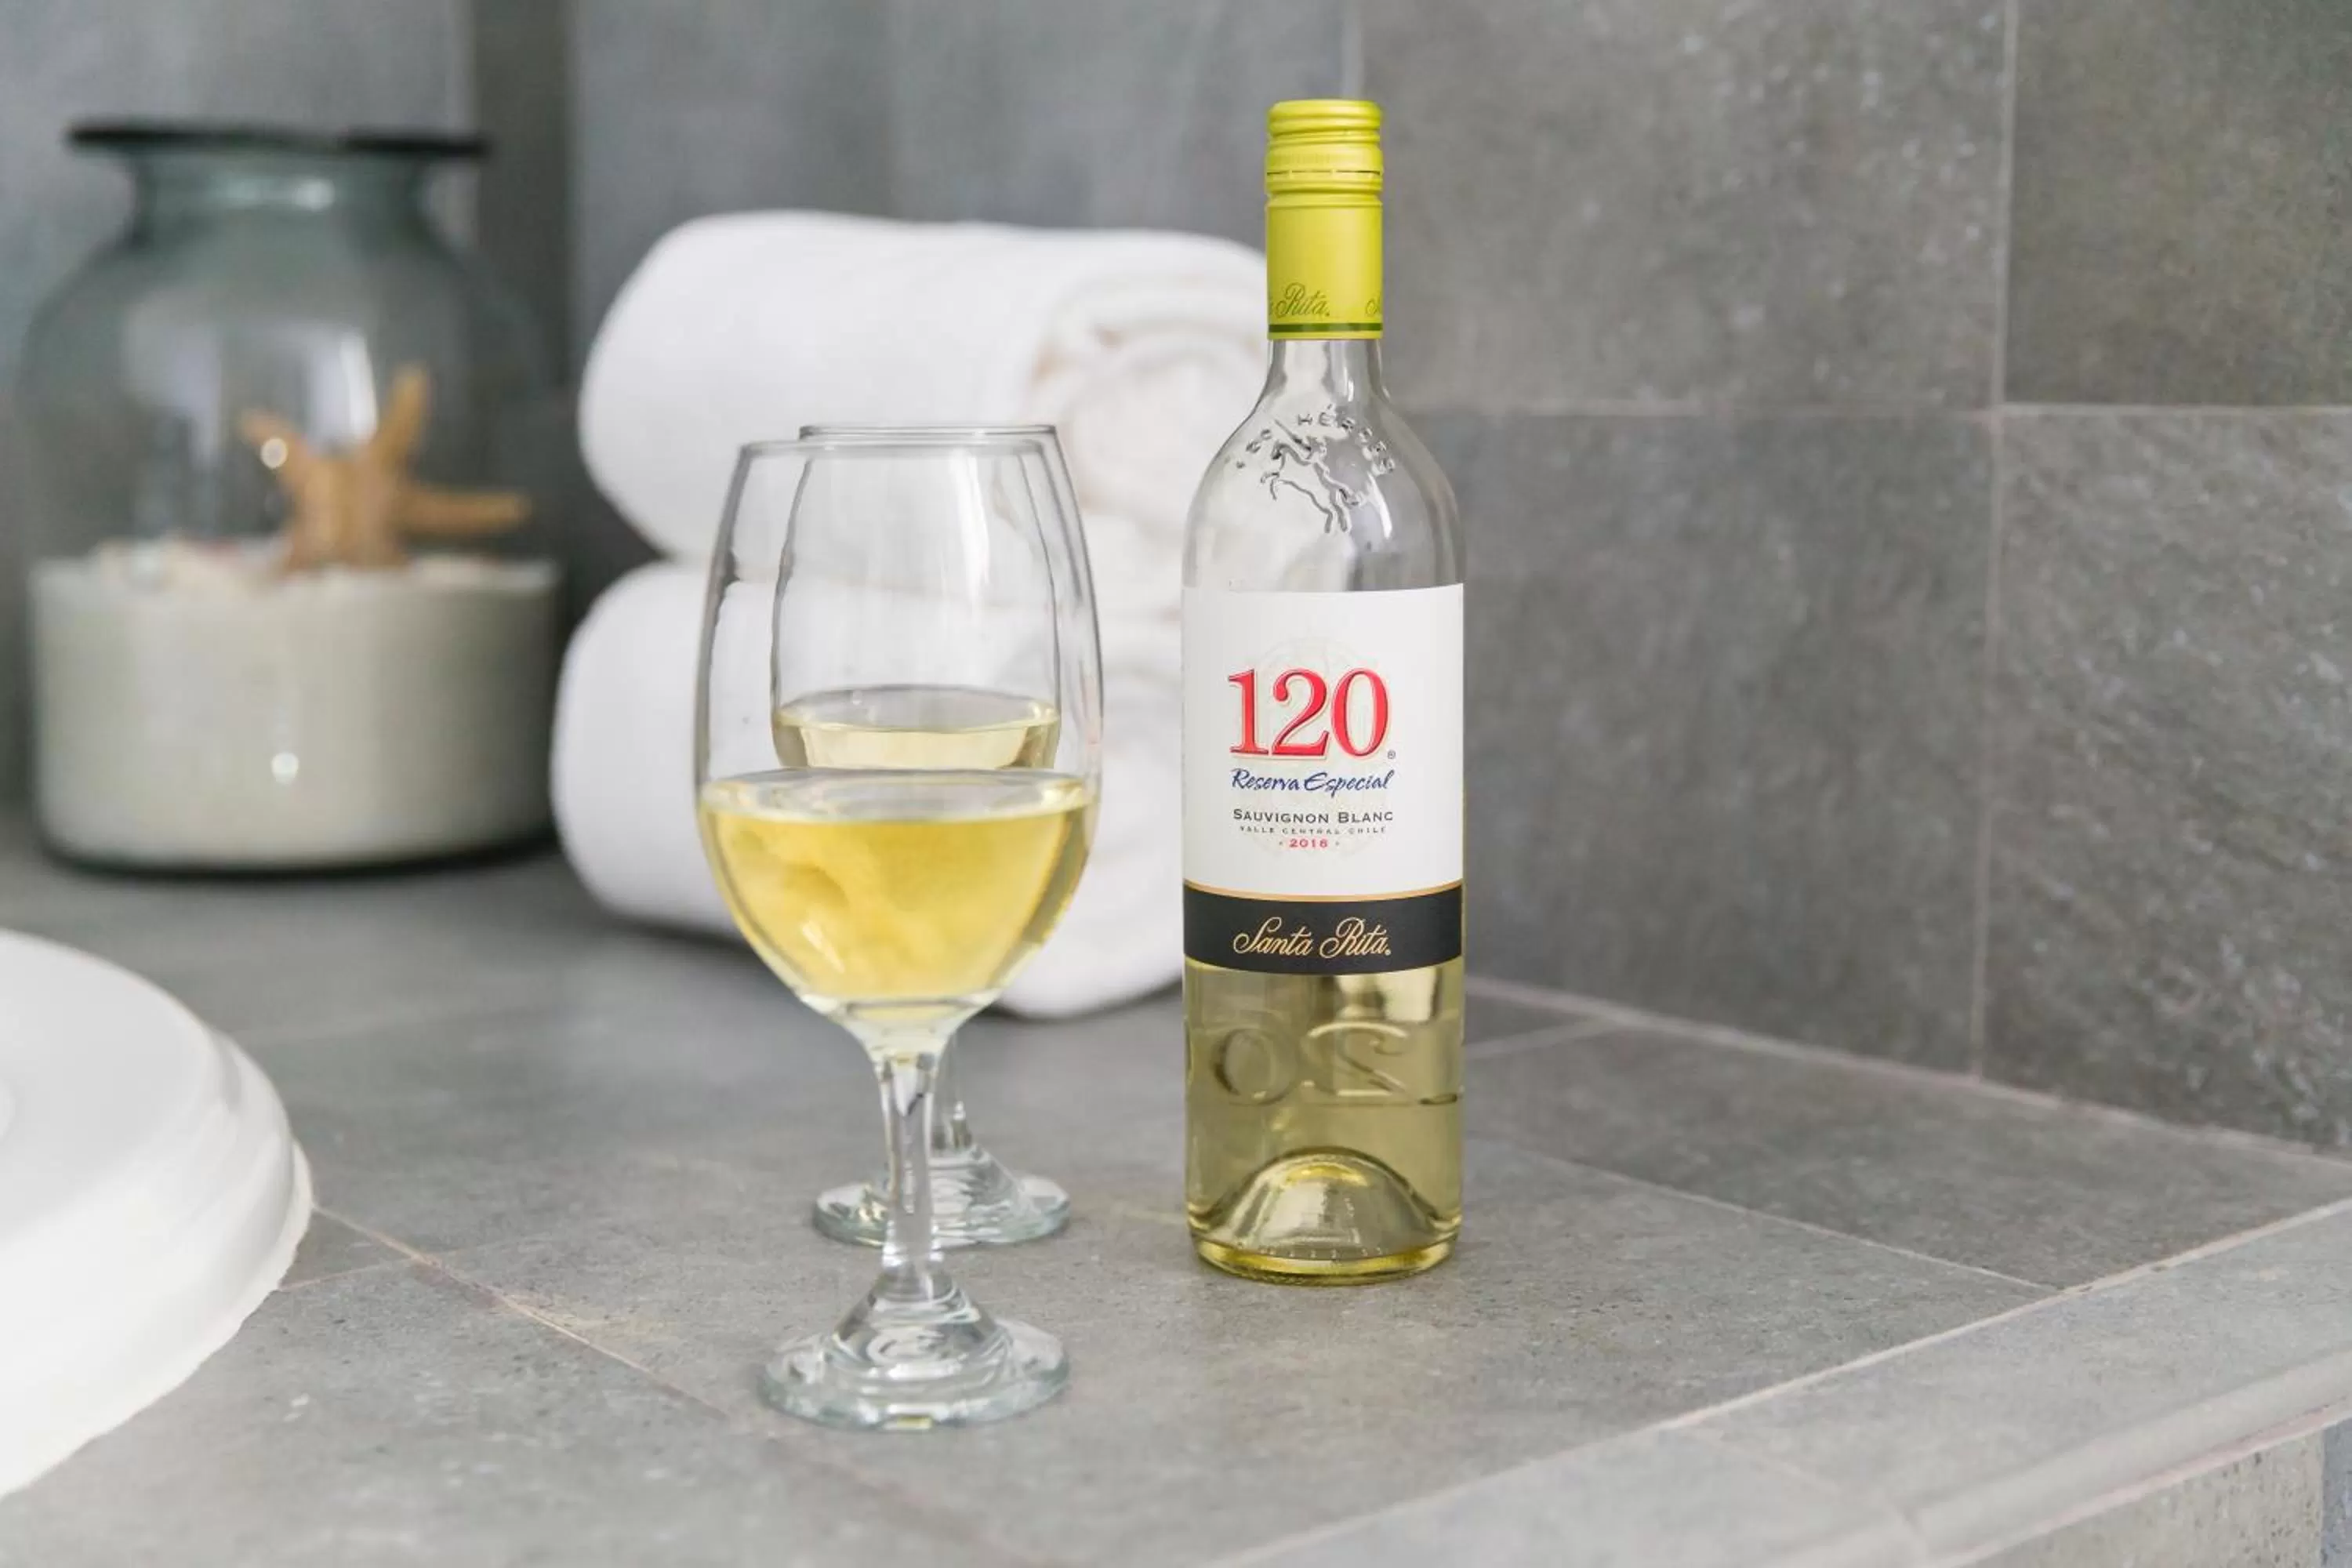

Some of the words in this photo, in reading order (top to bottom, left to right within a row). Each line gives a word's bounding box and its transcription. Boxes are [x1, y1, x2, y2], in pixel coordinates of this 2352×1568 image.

[1228, 667, 1389, 757] 120
[1230, 767, 1300, 789] Reserva
[1304, 768, 1396, 798] Especial
[1233, 808, 1330, 823] SAUVIGNON
[1338, 811, 1394, 823] BLANC
[1348, 826, 1387, 835] CHILE
[1232, 916, 1313, 956] Santa
